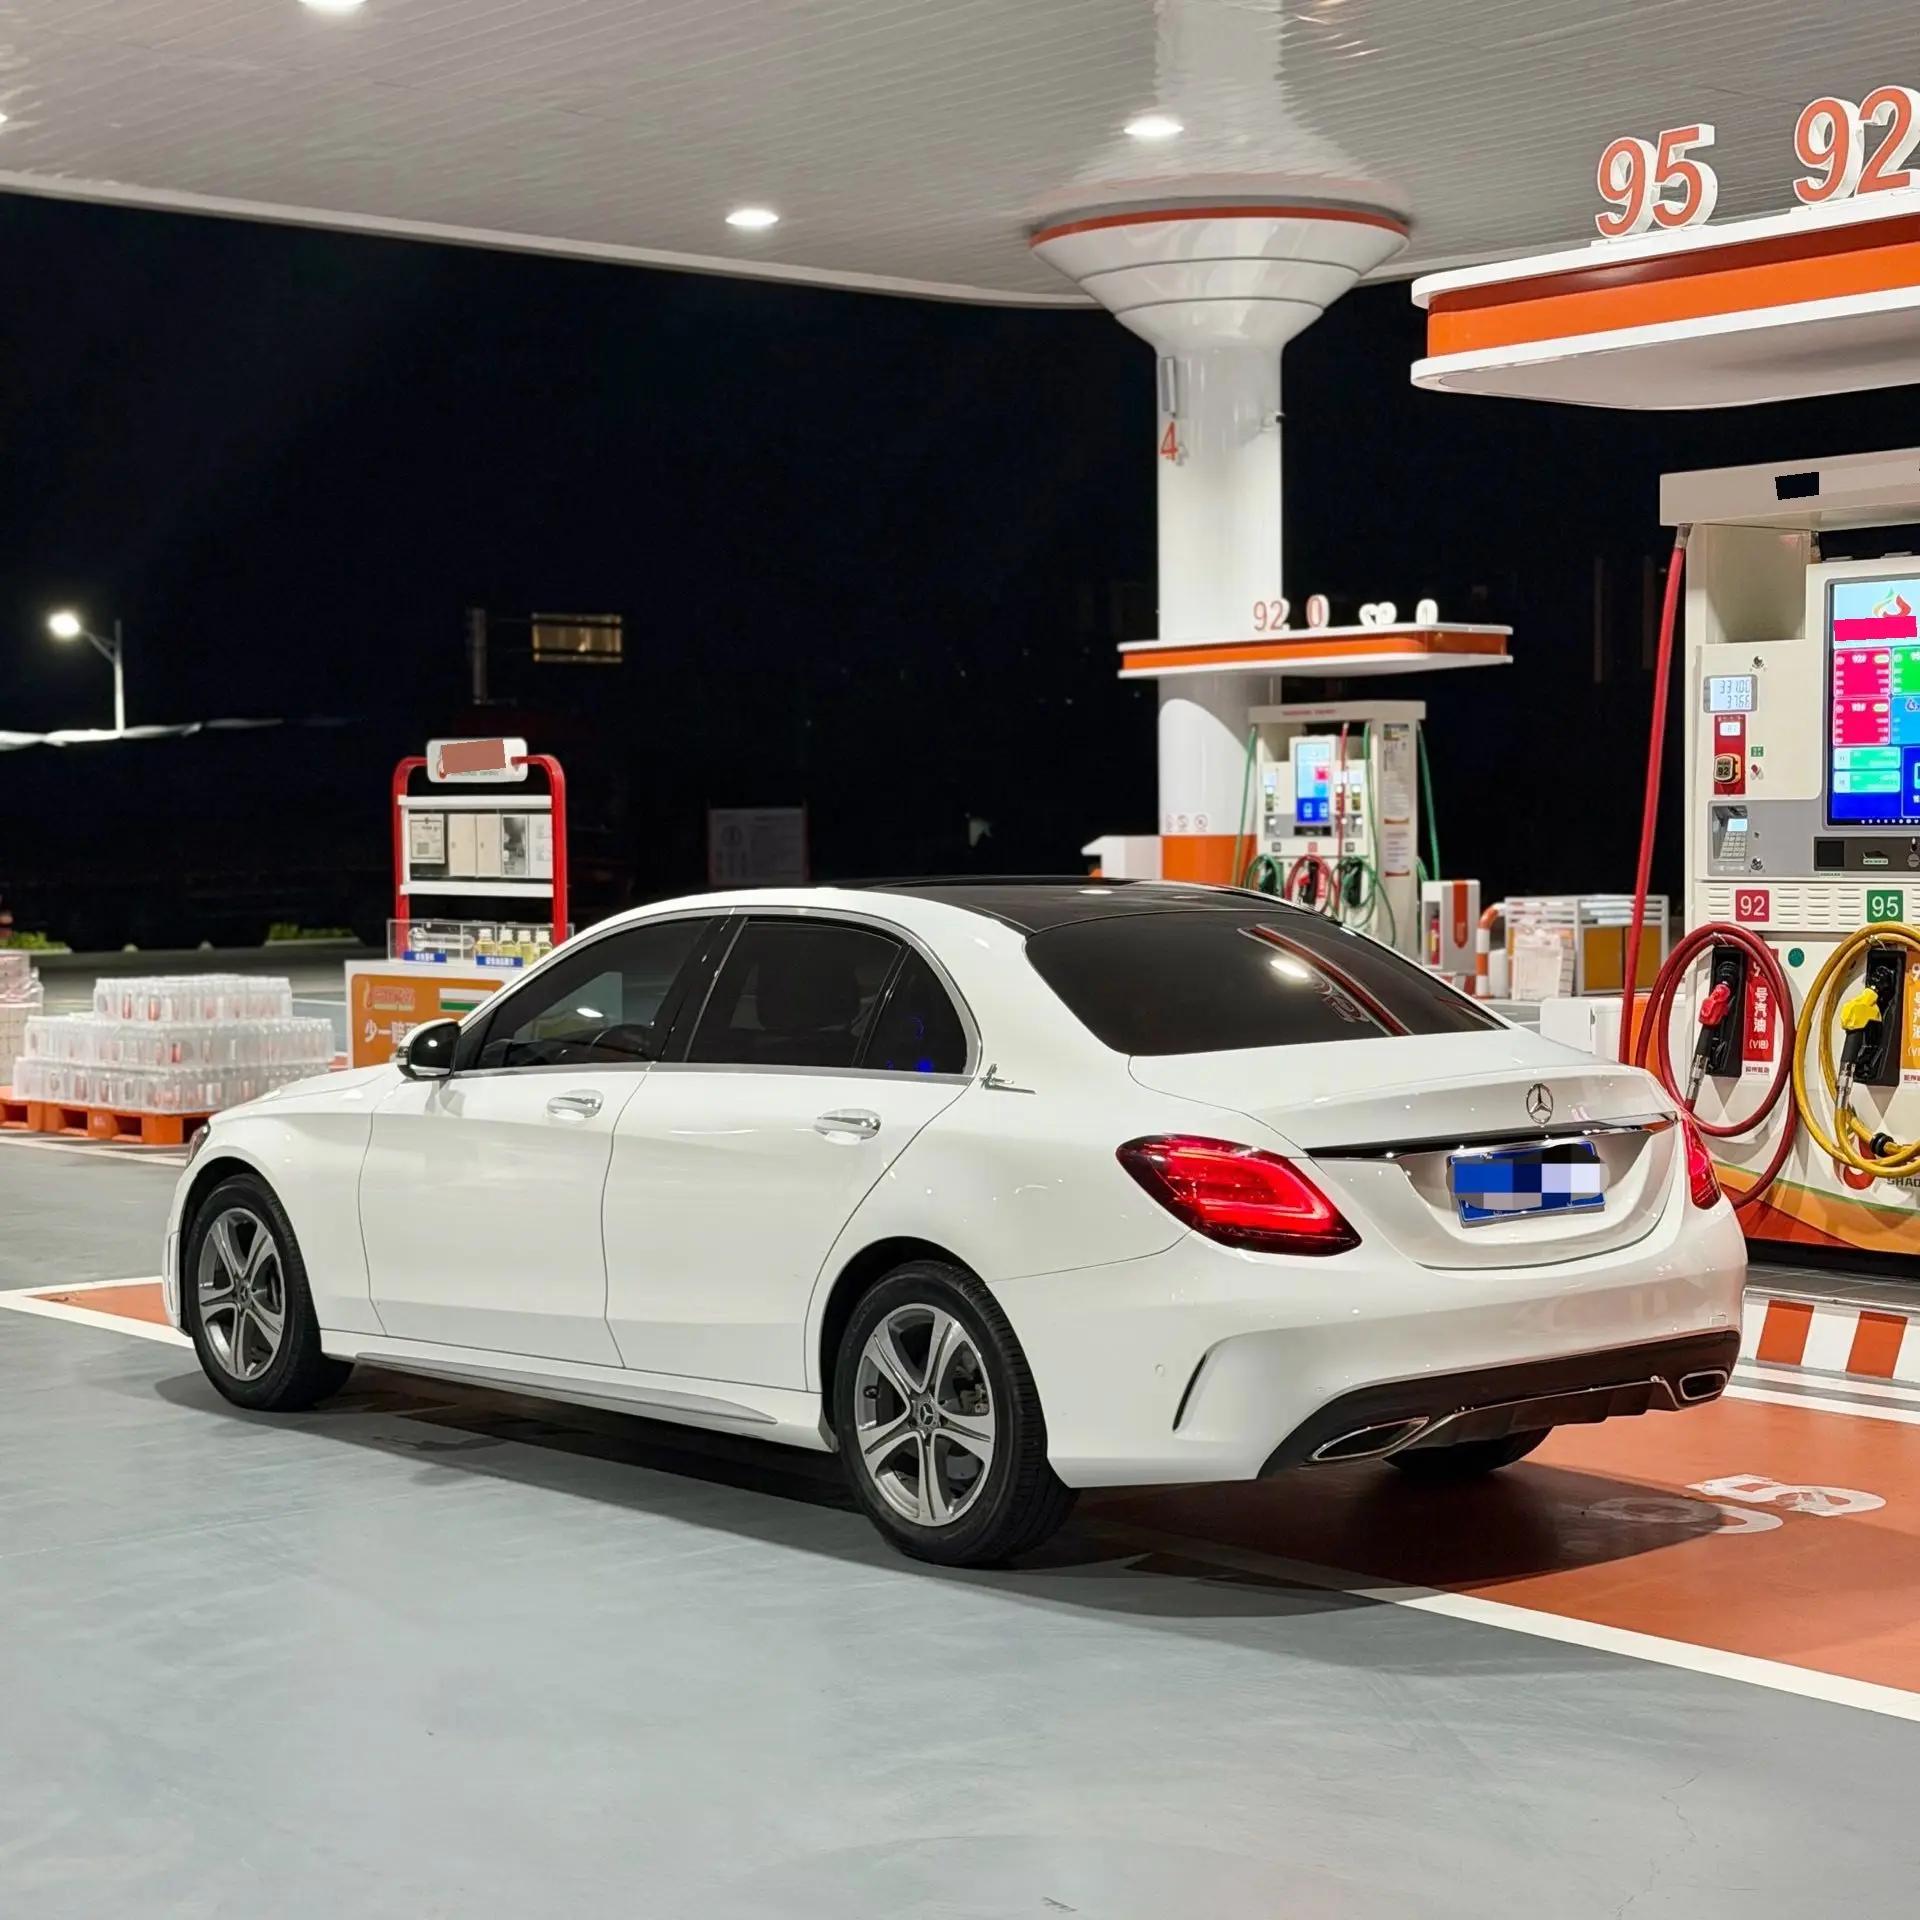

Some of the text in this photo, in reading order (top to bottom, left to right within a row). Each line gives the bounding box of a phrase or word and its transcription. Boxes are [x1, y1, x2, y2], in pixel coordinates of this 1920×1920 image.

[1595, 85, 1920, 238] 95 92
[1159, 421, 1179, 461] 4
[1253, 598, 1290, 631] 92
[1306, 594, 1330, 629] 0
[1717, 766, 1730, 776] 92
[1740, 895, 1899, 918] 92 95
[1753, 987, 1769, 1033] 号汽油
